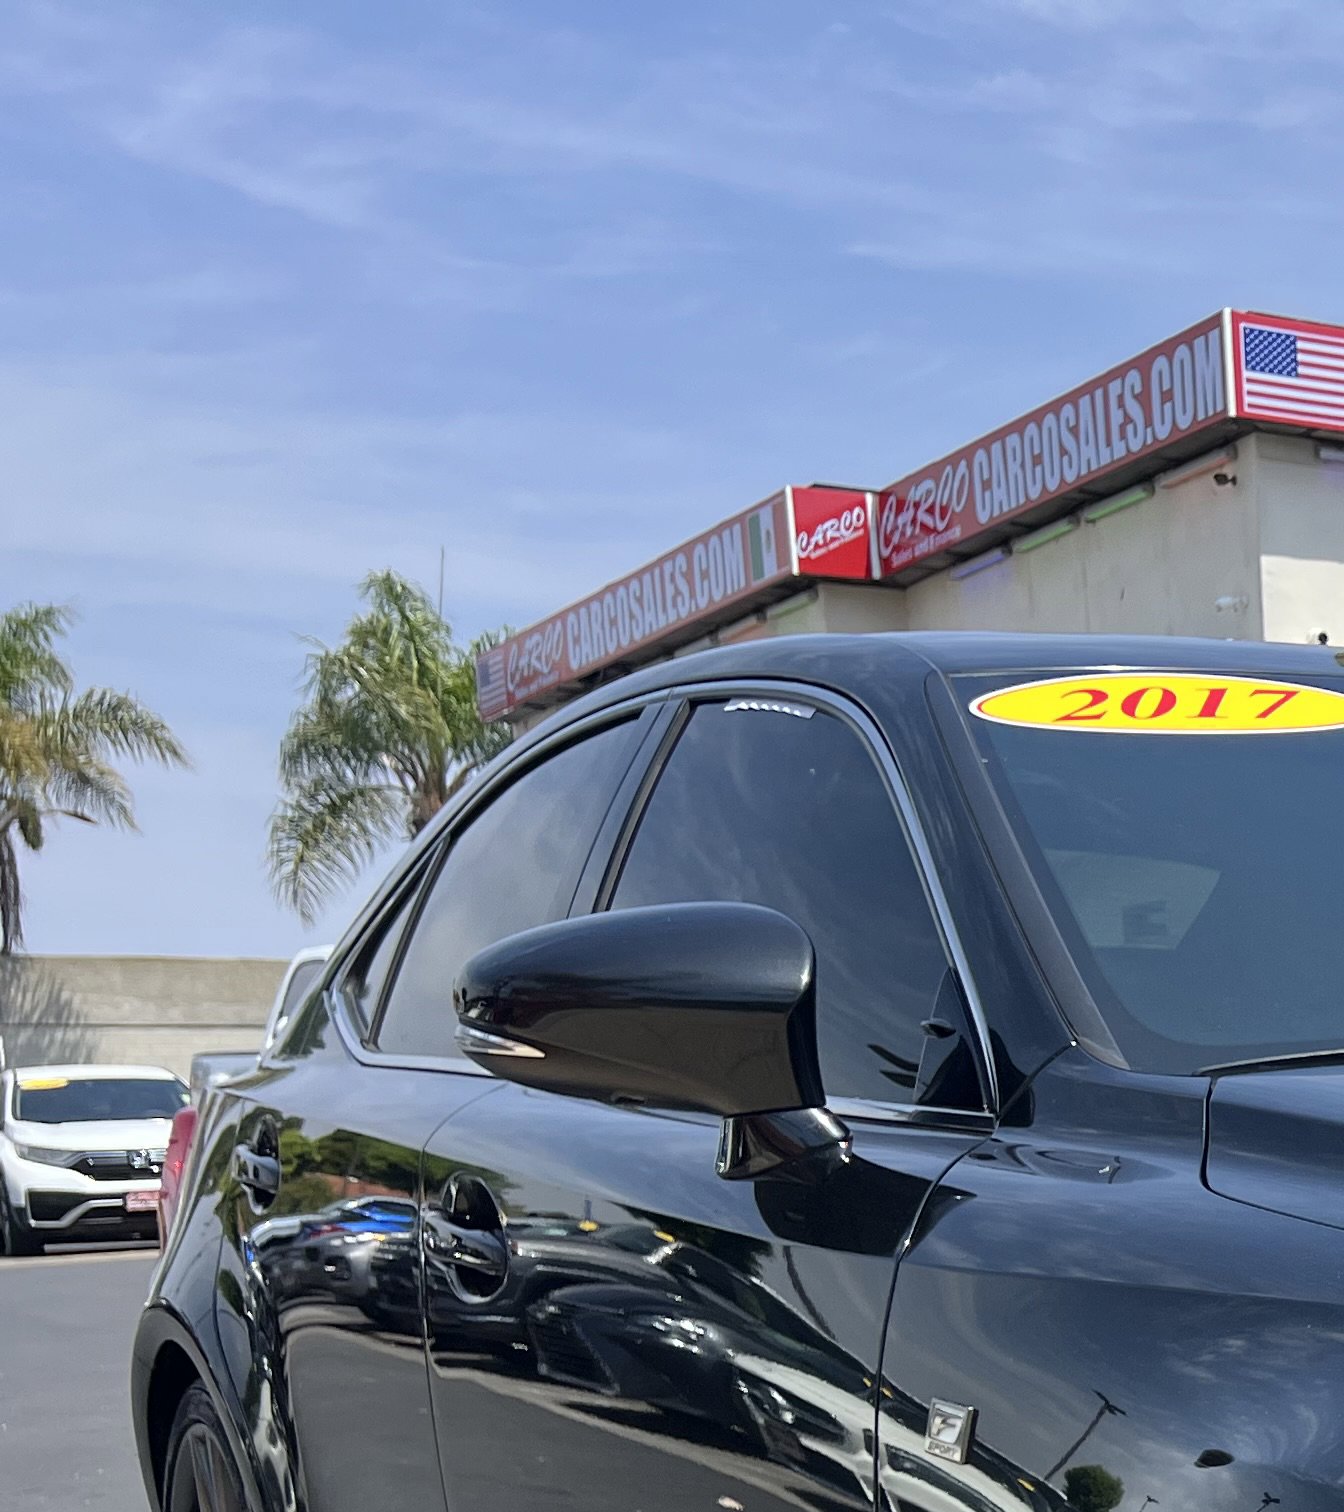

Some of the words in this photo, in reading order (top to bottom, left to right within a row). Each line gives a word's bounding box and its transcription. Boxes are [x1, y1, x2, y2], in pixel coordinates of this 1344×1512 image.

[880, 458, 969, 559] CARCO
[973, 326, 1224, 524] CARCOSALES.COM
[798, 506, 865, 558] CARCO
[507, 619, 563, 692] CARCO
[567, 523, 746, 672] CARCOSALES.COM
[1052, 686, 1300, 723] 2017
